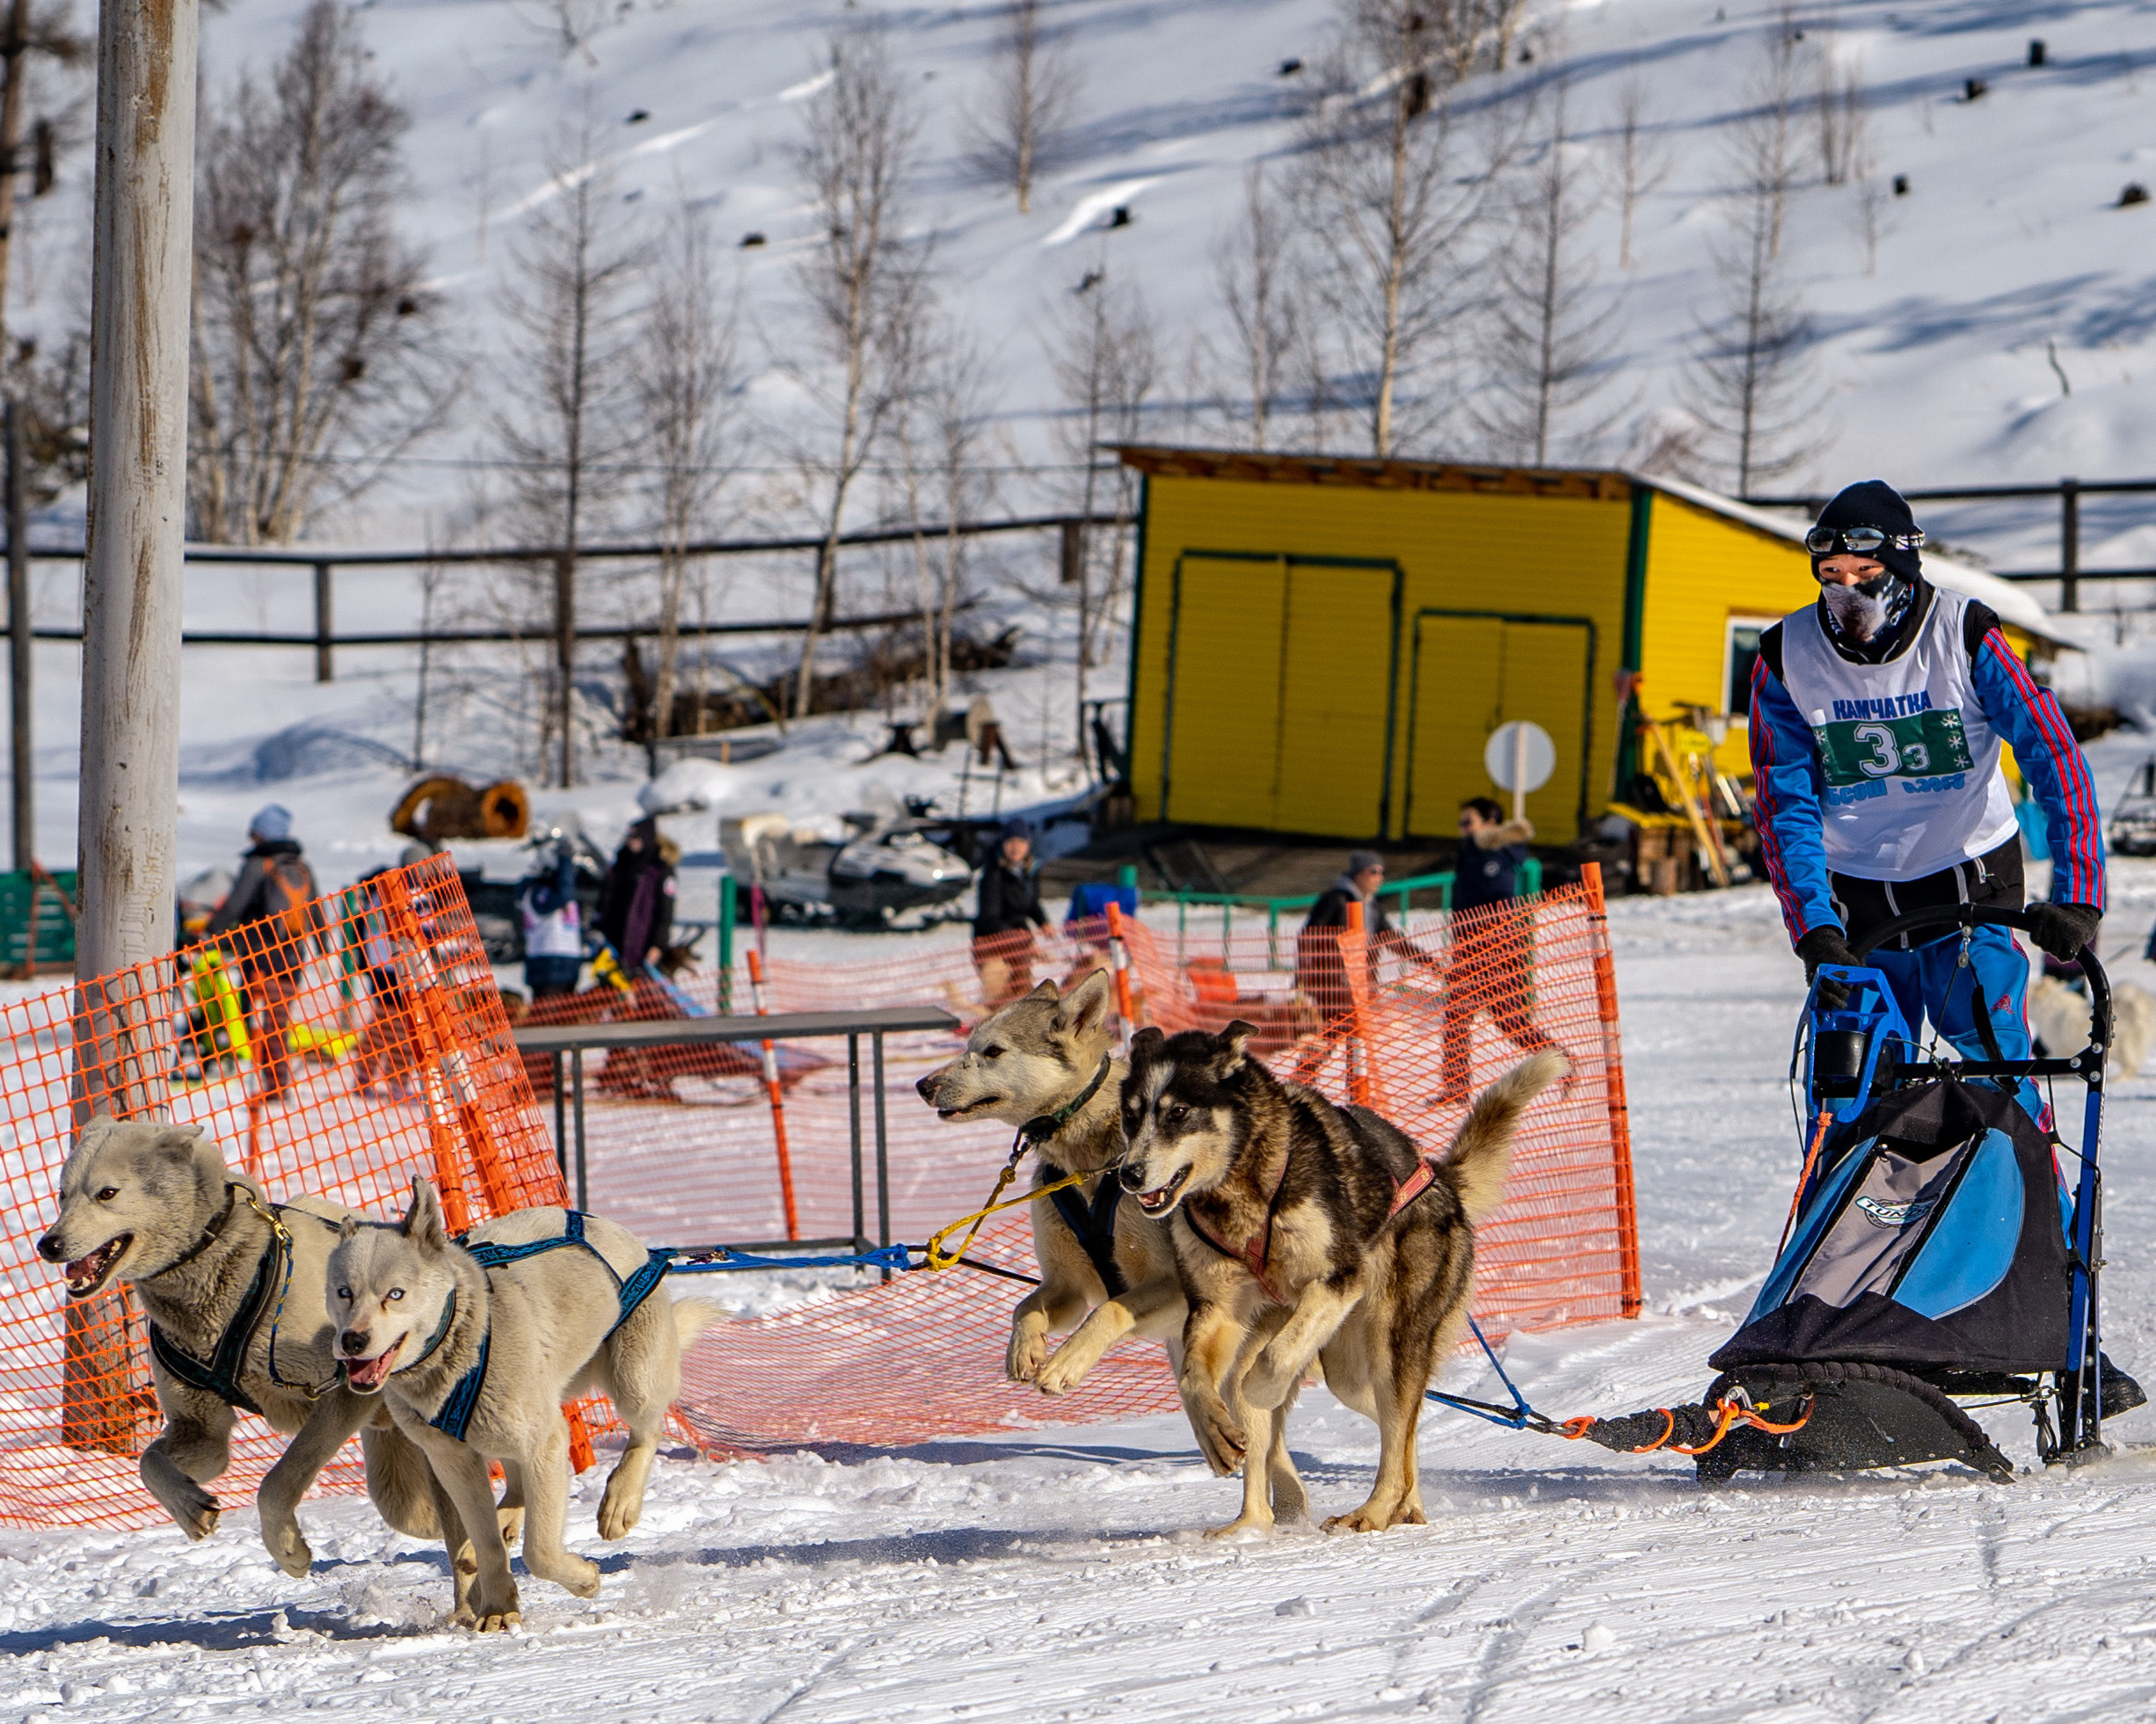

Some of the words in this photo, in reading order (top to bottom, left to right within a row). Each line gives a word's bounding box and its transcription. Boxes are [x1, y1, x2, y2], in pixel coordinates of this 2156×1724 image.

[1832, 690, 1933, 720] КАМЧАТКА
[1854, 724, 1903, 778] 3
[1902, 742, 1930, 772] 3
